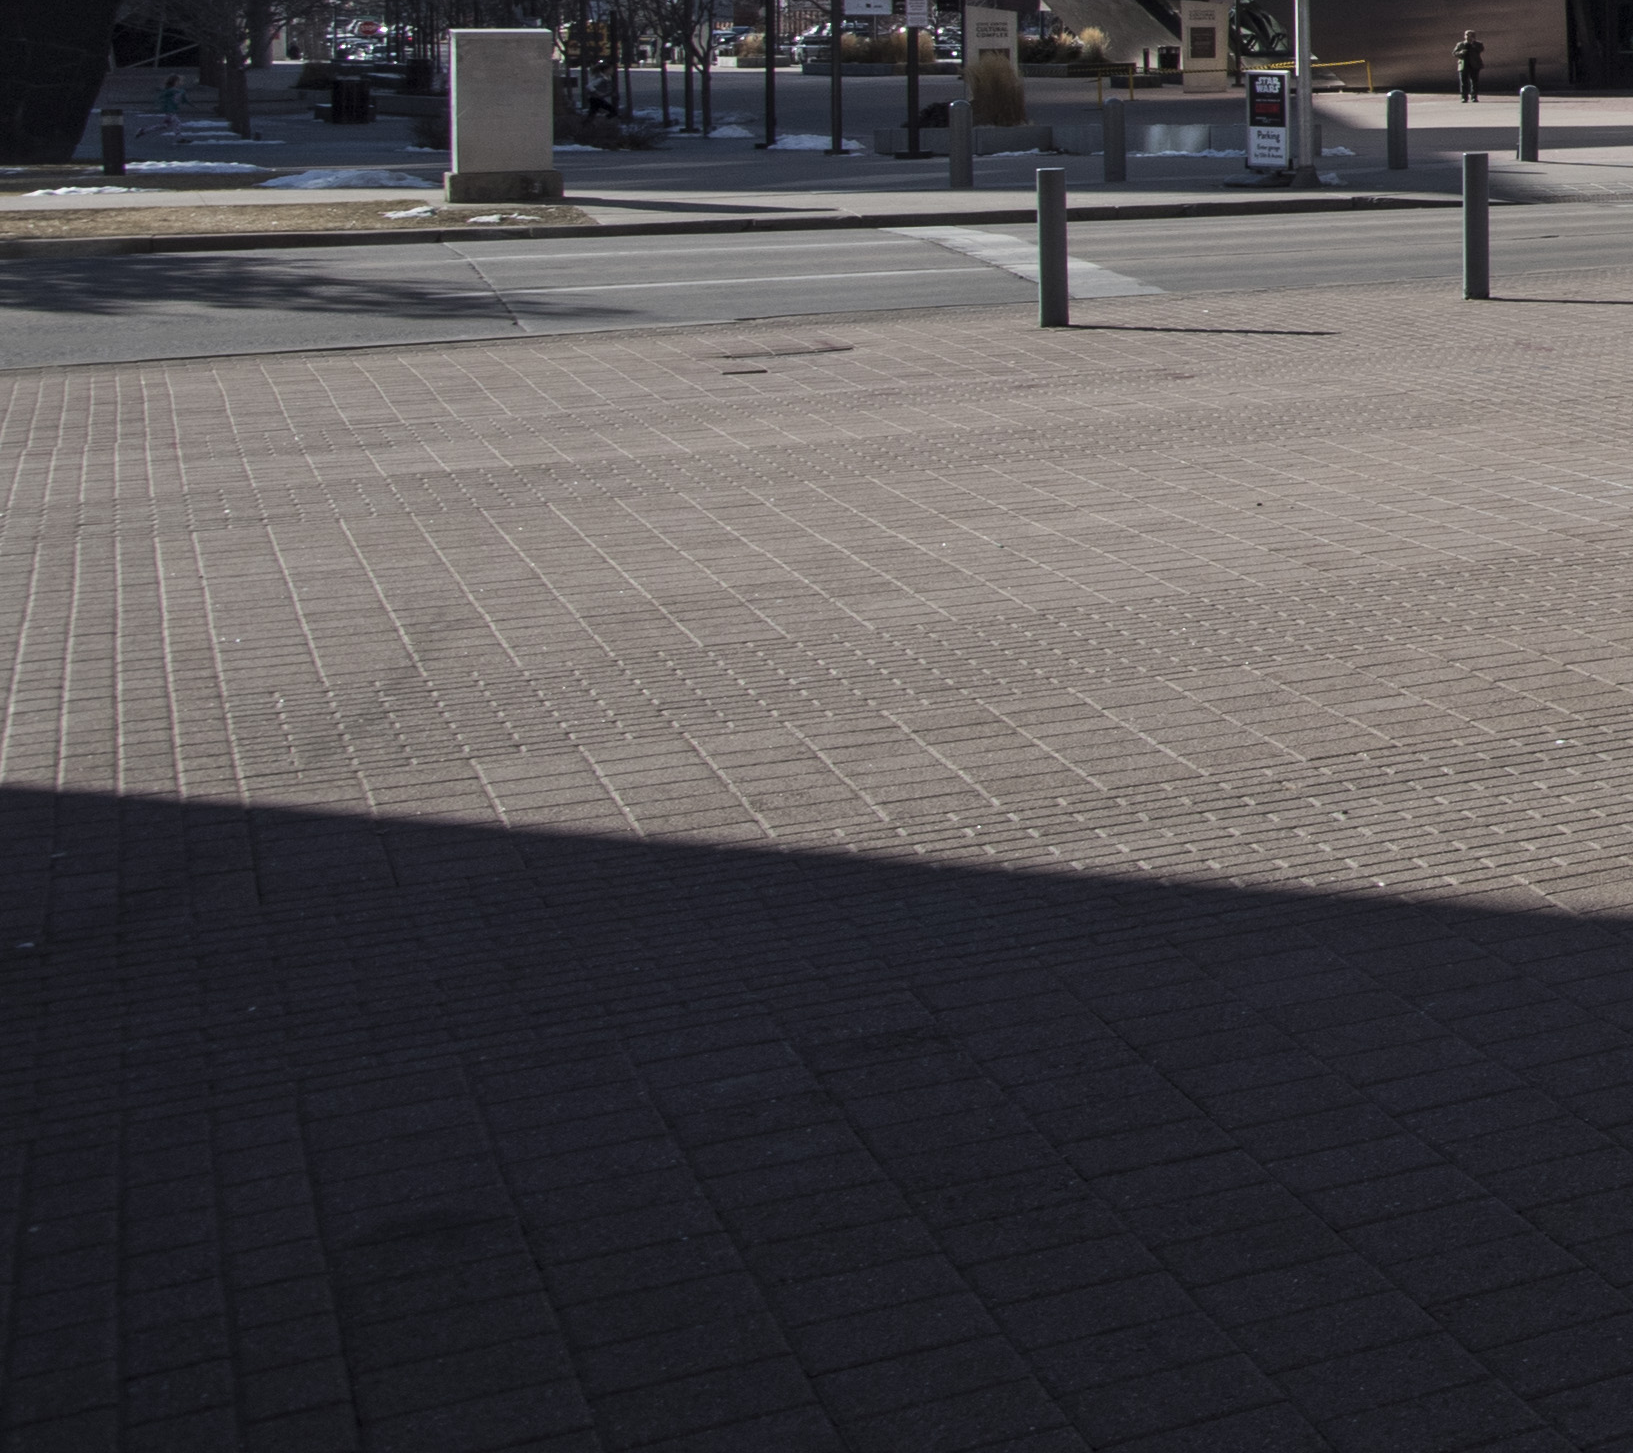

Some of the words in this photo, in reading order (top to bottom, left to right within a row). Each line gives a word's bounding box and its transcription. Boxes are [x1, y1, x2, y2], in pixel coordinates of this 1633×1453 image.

[1255, 76, 1280, 85] STAR
[1255, 84, 1280, 94] WARS
[1257, 130, 1280, 143] Parking
